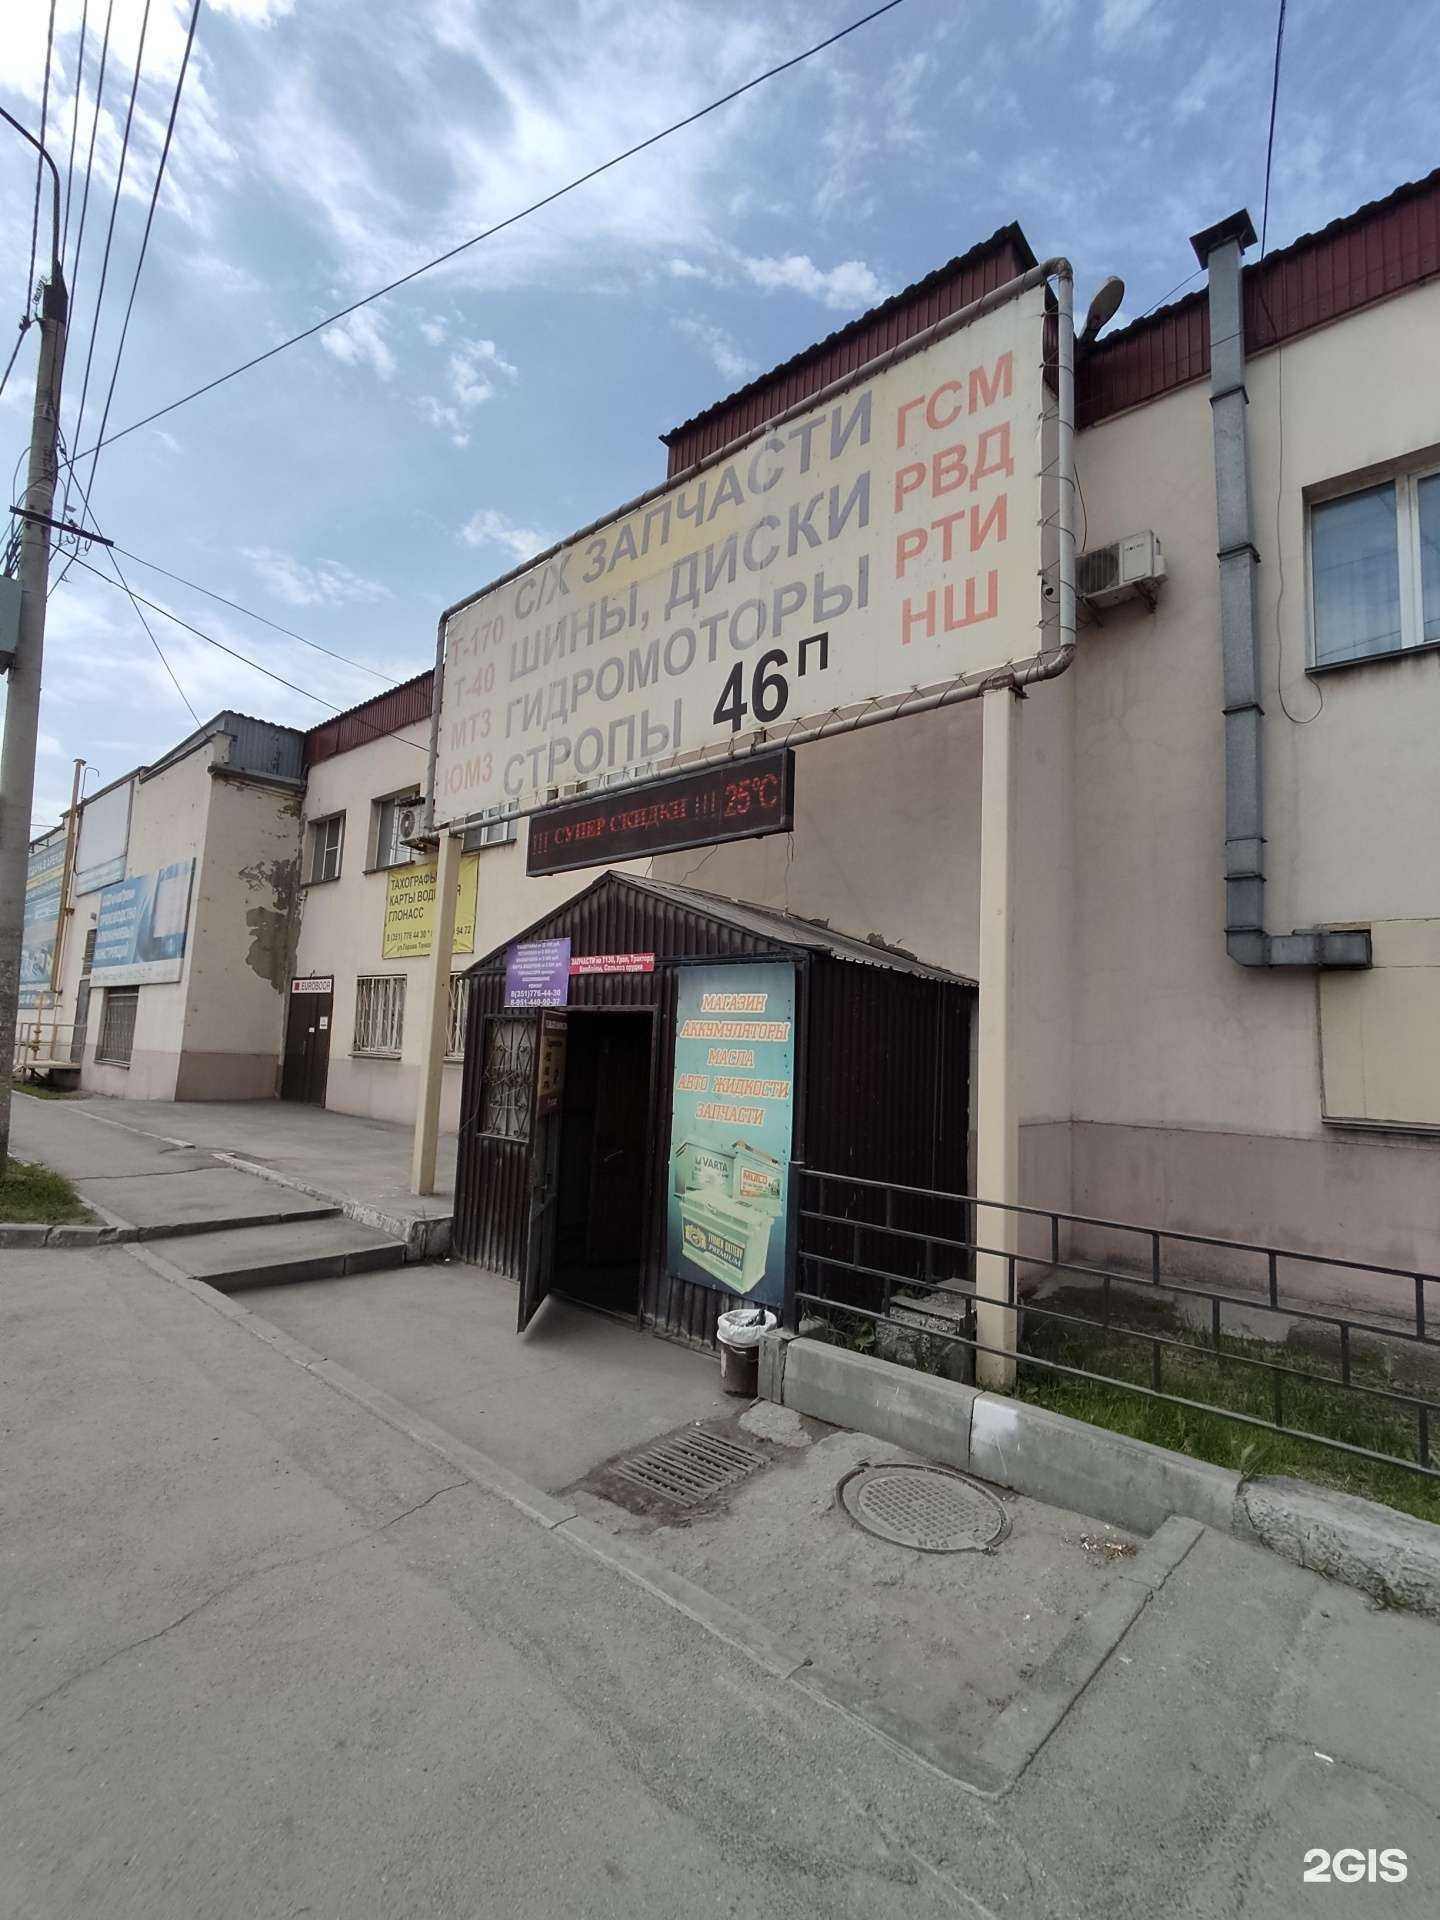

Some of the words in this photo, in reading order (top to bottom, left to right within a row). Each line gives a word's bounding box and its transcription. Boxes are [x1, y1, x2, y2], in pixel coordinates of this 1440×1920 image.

[896, 350, 1014, 450] ГСМ
[893, 420, 1015, 514] РВД
[514, 550, 573, 620] С/Х
[582, 389, 873, 584] ЗАПЧАСТИ
[895, 492, 1008, 579] РТИ
[509, 580, 650, 682] ШИНЫ,
[663, 470, 871, 622] ДИСКИ
[901, 568, 999, 646] НШ
[505, 553, 870, 739] ГИДРОМОТОРЫ
[503, 697, 683, 796] СТРОПЫ
[390, 871, 437, 891] ТАХОГРАФЫ
[389, 892, 416, 906] КАРТЫ
[388, 906, 425, 922] ГЛОНАСС
[701, 993, 768, 1013] МАГАЗИН
[680, 1020, 791, 1042] АККУМУЛЯТОРЫ
[707, 1048, 755, 1068] МАСЛА
[677, 1073, 710, 1093] АВТО
[713, 1075, 790, 1100] ЖИДКОСТИ
[695, 1101, 766, 1127] ЗАПЧАСТИ
[703, 1157, 728, 1173] VARTA
